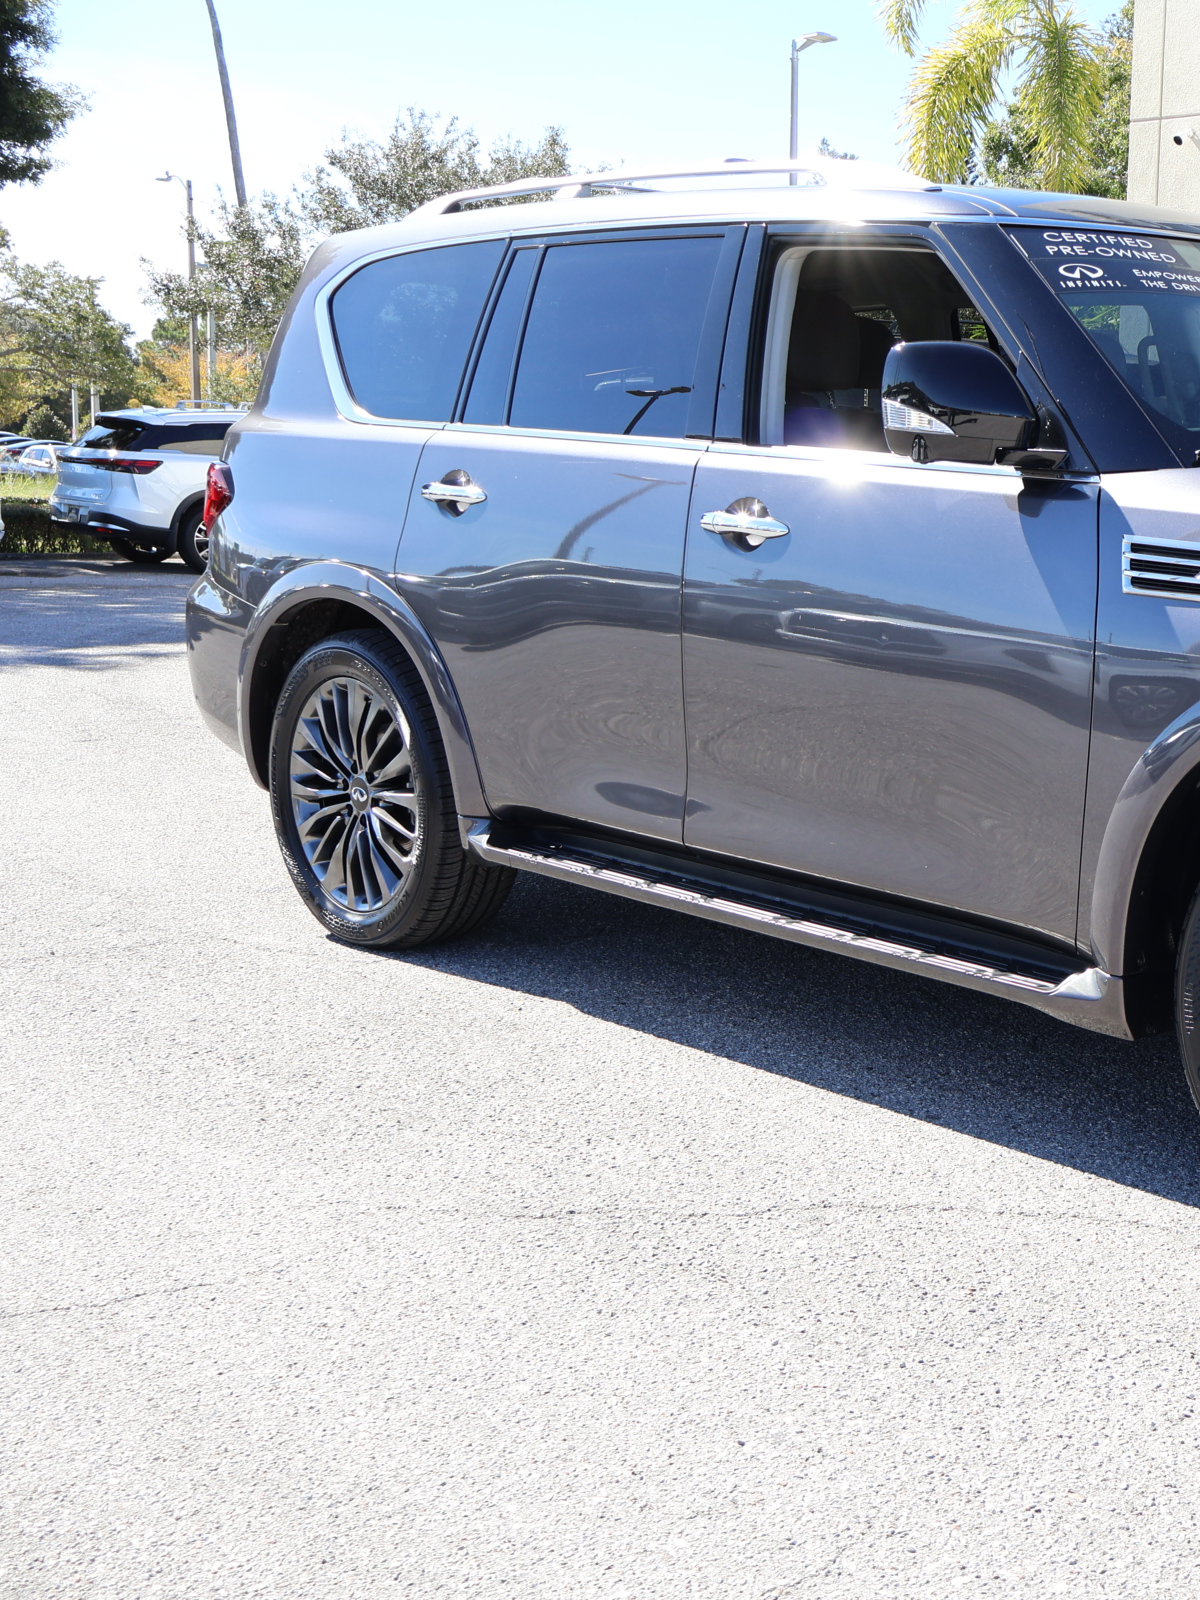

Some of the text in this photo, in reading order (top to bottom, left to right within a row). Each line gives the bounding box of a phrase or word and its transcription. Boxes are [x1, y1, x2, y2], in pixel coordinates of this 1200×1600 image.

[1043, 232, 1153, 249] CERTIFIED
[1045, 245, 1176, 263] PRE-OWNED
[1059, 280, 1122, 288] INFINITI
[1140, 279, 1169, 289] THE
